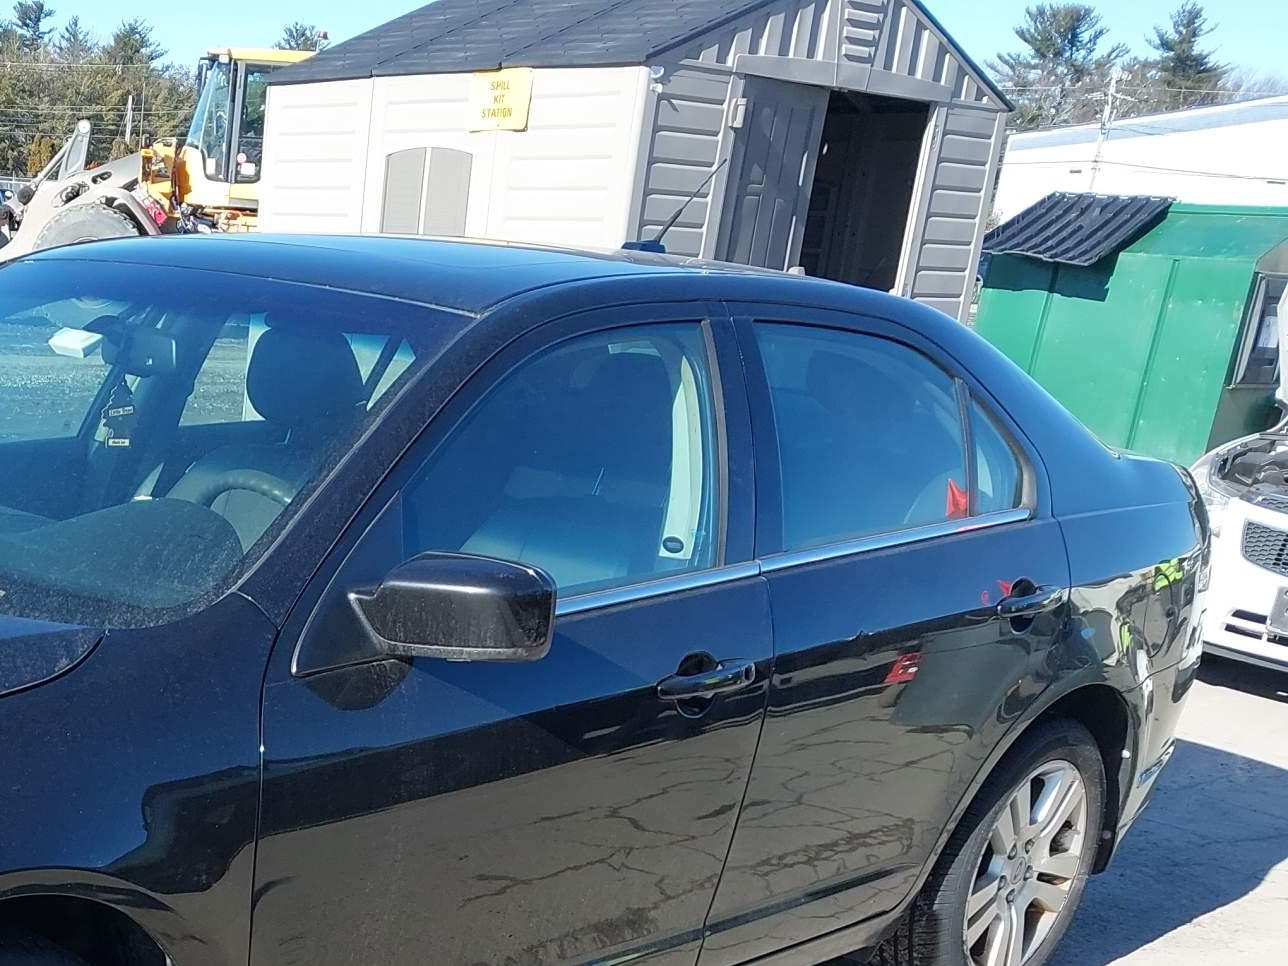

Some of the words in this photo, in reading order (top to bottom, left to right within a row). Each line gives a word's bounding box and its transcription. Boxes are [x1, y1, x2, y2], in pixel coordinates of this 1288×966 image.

[490, 80, 510, 91] SPILL
[493, 94, 505, 104] KIT
[481, 107, 513, 118] STATION
